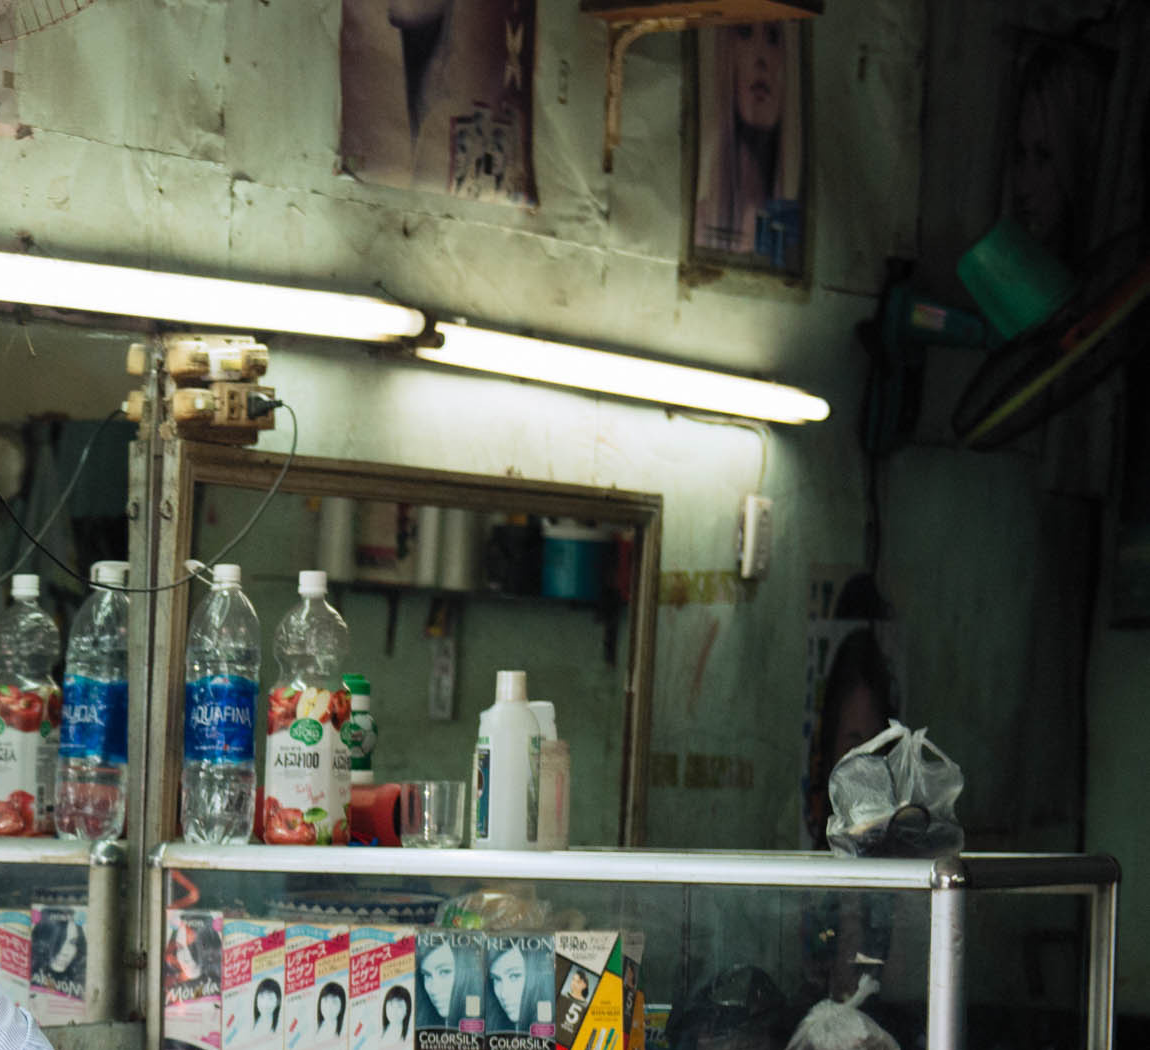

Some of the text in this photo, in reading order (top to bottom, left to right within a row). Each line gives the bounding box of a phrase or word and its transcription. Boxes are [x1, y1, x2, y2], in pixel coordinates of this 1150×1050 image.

[417, 932, 486, 947] REVLON
[487, 936, 555, 951] REVLON
[419, 1031, 478, 1045] COLORSILK
[489, 1036, 550, 1050] COLORSILK
